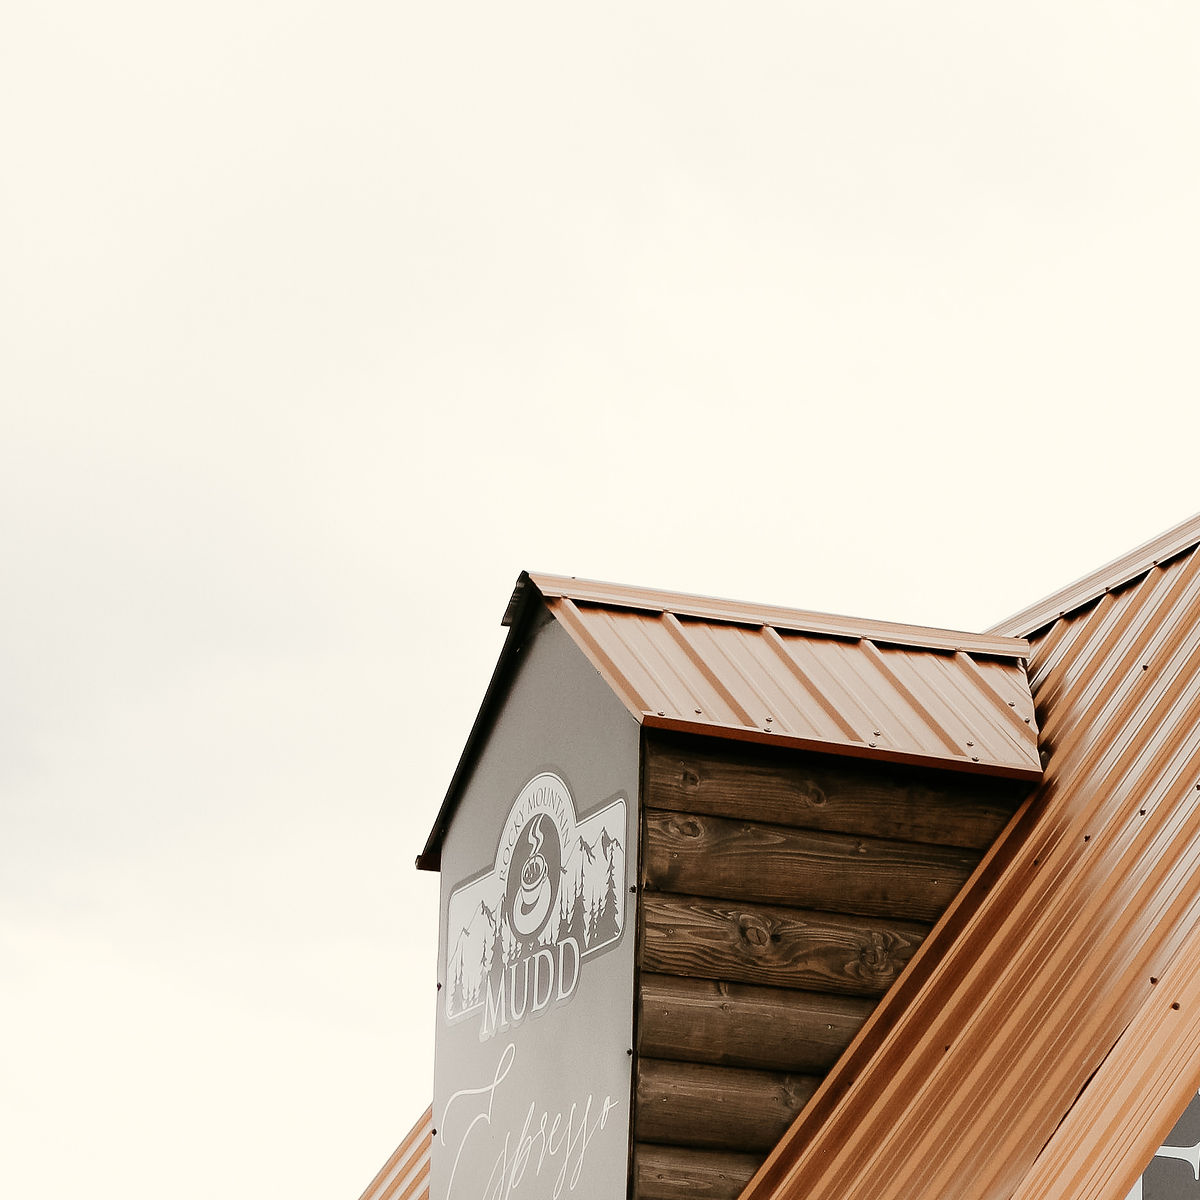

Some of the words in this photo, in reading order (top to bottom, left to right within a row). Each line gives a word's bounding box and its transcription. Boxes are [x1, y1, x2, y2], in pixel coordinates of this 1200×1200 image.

[499, 803, 525, 881] ROCKY
[527, 786, 571, 849] MOUNTAIN
[481, 936, 580, 1035] MUDD
